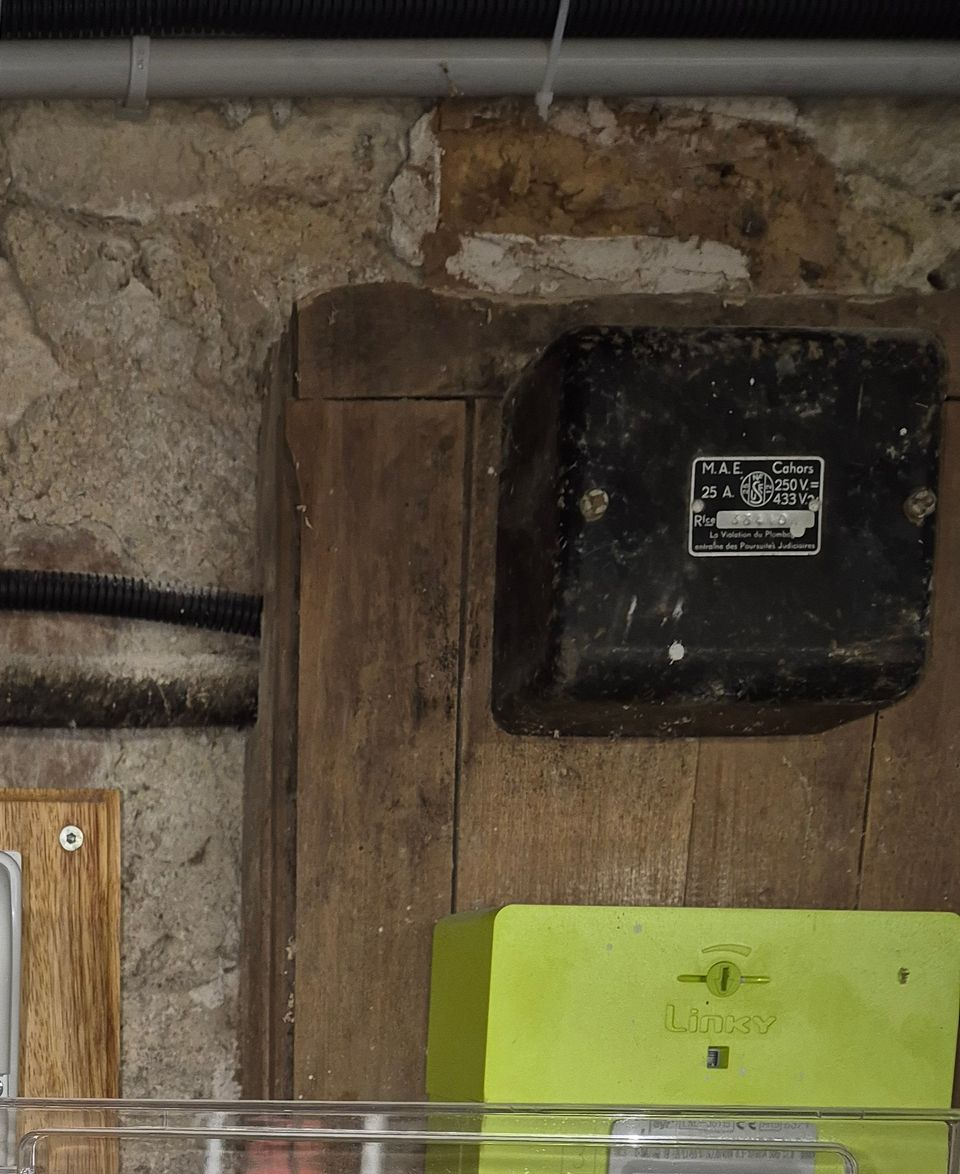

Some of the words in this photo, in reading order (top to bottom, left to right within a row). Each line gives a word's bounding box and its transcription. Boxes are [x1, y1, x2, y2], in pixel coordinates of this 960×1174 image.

[702, 462, 743, 475] M.A.E.
[772, 461, 814, 474] Cahors
[774, 479, 797, 491] 250
[701, 486, 718, 498] 25
[773, 493, 796, 505] 433
[740, 541, 776, 550] Poursuites
[778, 541, 816, 550] Judiciaires
